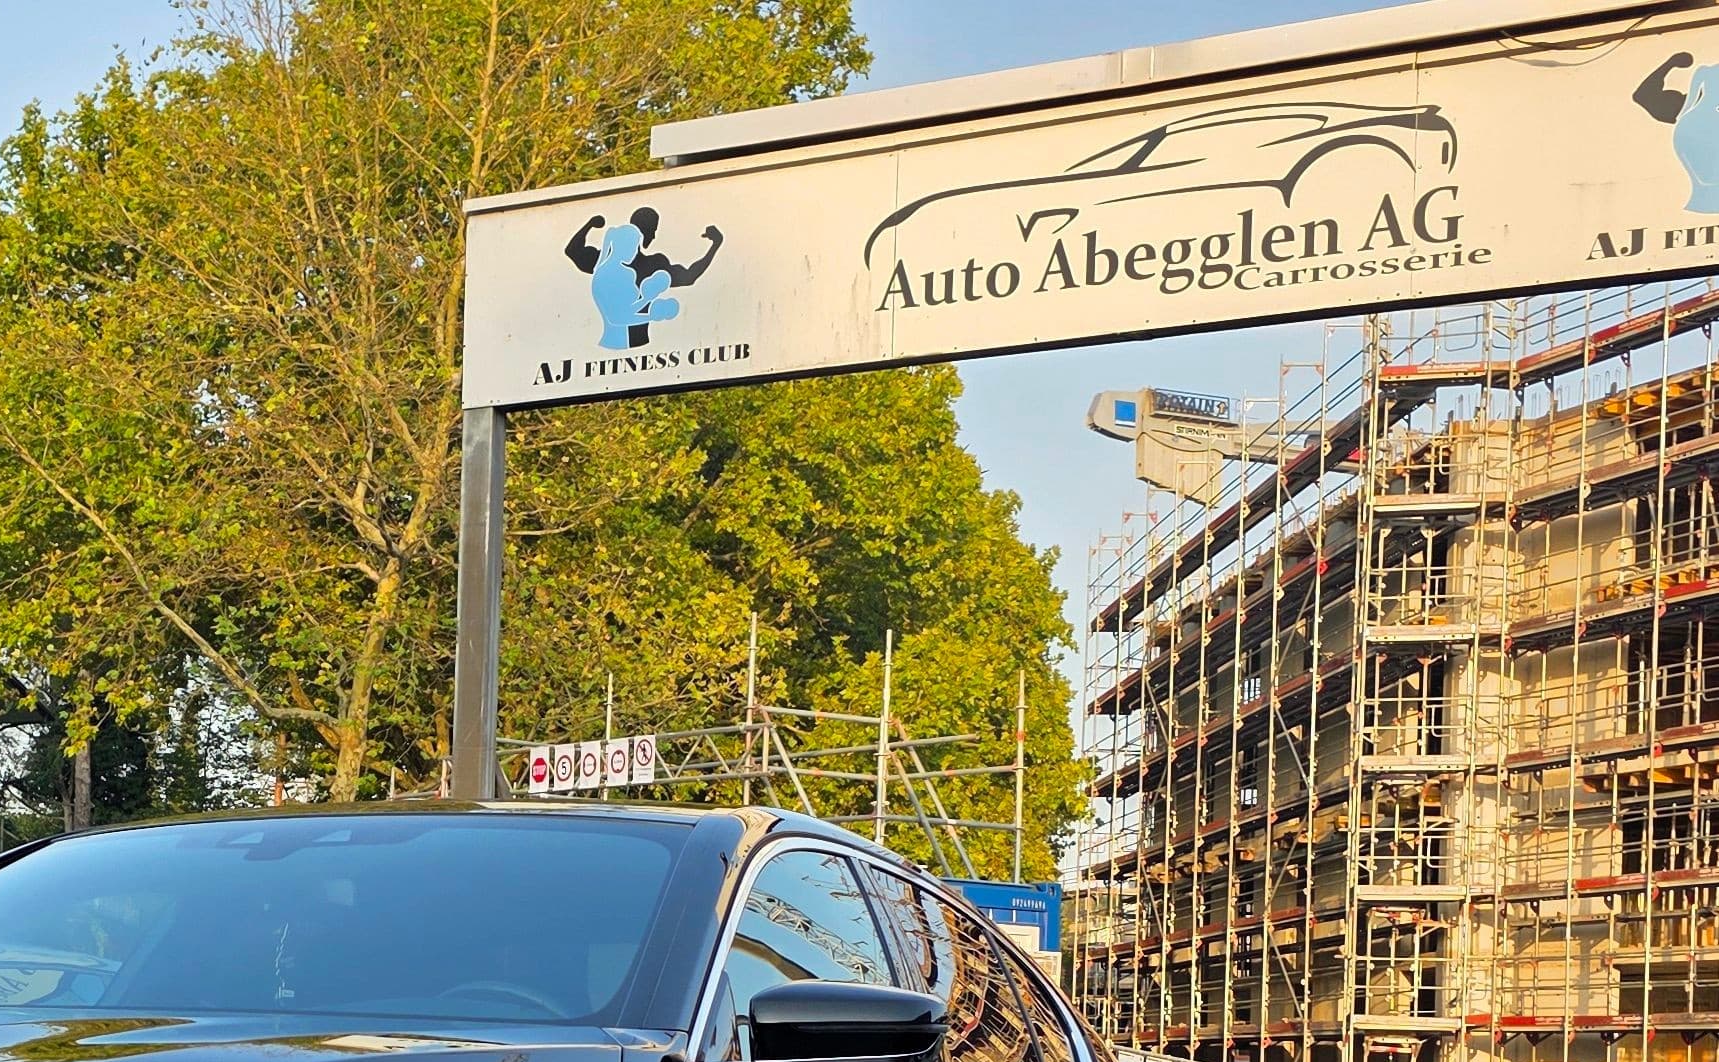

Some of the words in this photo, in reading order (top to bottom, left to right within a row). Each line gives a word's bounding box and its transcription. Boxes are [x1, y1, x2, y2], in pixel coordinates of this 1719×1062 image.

[875, 257, 1021, 312] Auto
[1033, 209, 1342, 295] Abegglen
[1357, 185, 1465, 252] AG
[1585, 227, 1648, 260] AJ
[1664, 225, 1719, 250] FIT
[1233, 244, 1493, 292] Carrosserie
[532, 358, 574, 386] AJ
[584, 351, 681, 378] FITNESS
[687, 343, 751, 366] CLUB
[561, 761, 567, 776] 5
